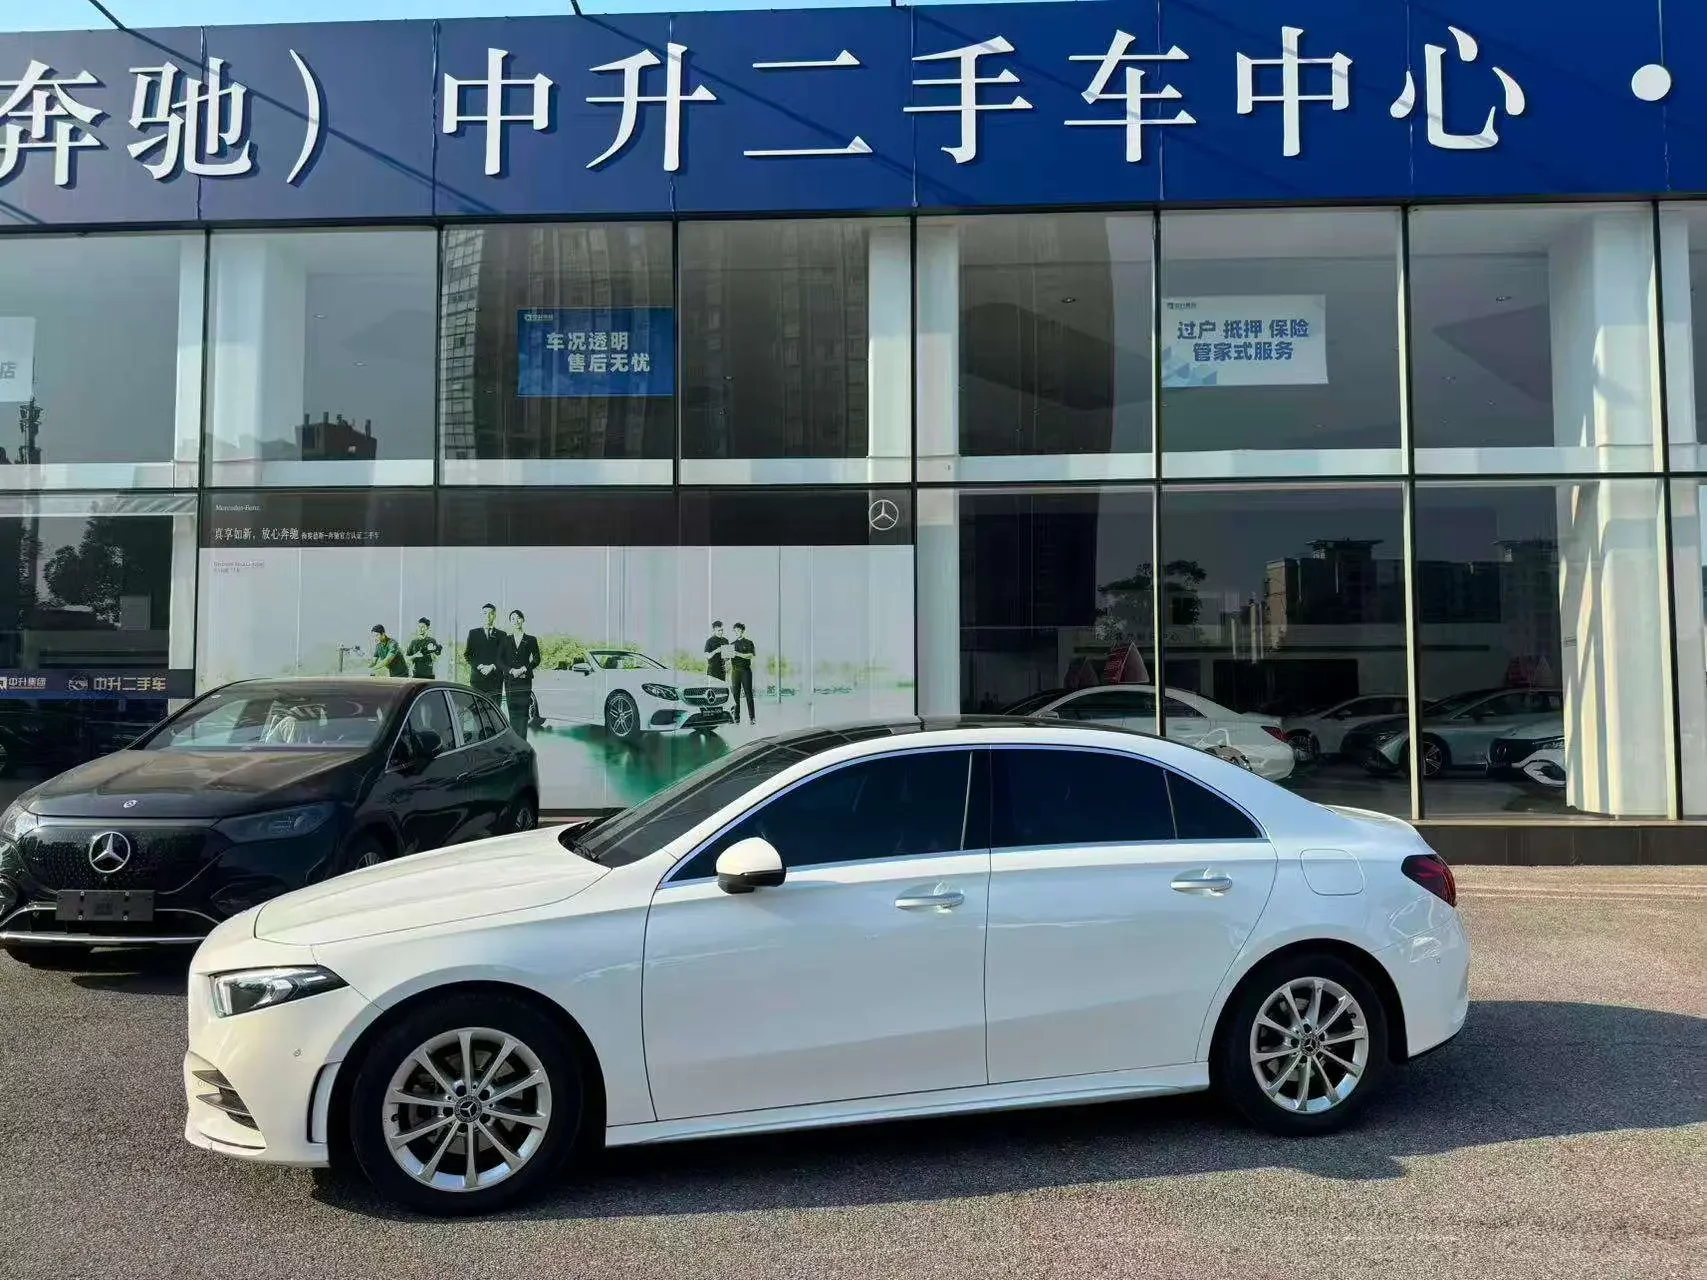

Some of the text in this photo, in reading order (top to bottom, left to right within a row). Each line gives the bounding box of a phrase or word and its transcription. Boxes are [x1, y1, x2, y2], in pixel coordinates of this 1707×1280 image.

[1177, 318, 1310, 340] 过户 抵押 保险
[546, 332, 629, 351] 车况透明
[1193, 341, 1294, 362] 管家式服务
[567, 353, 651, 373] 售后无忧
[94, 676, 167, 691] 中升二手车
